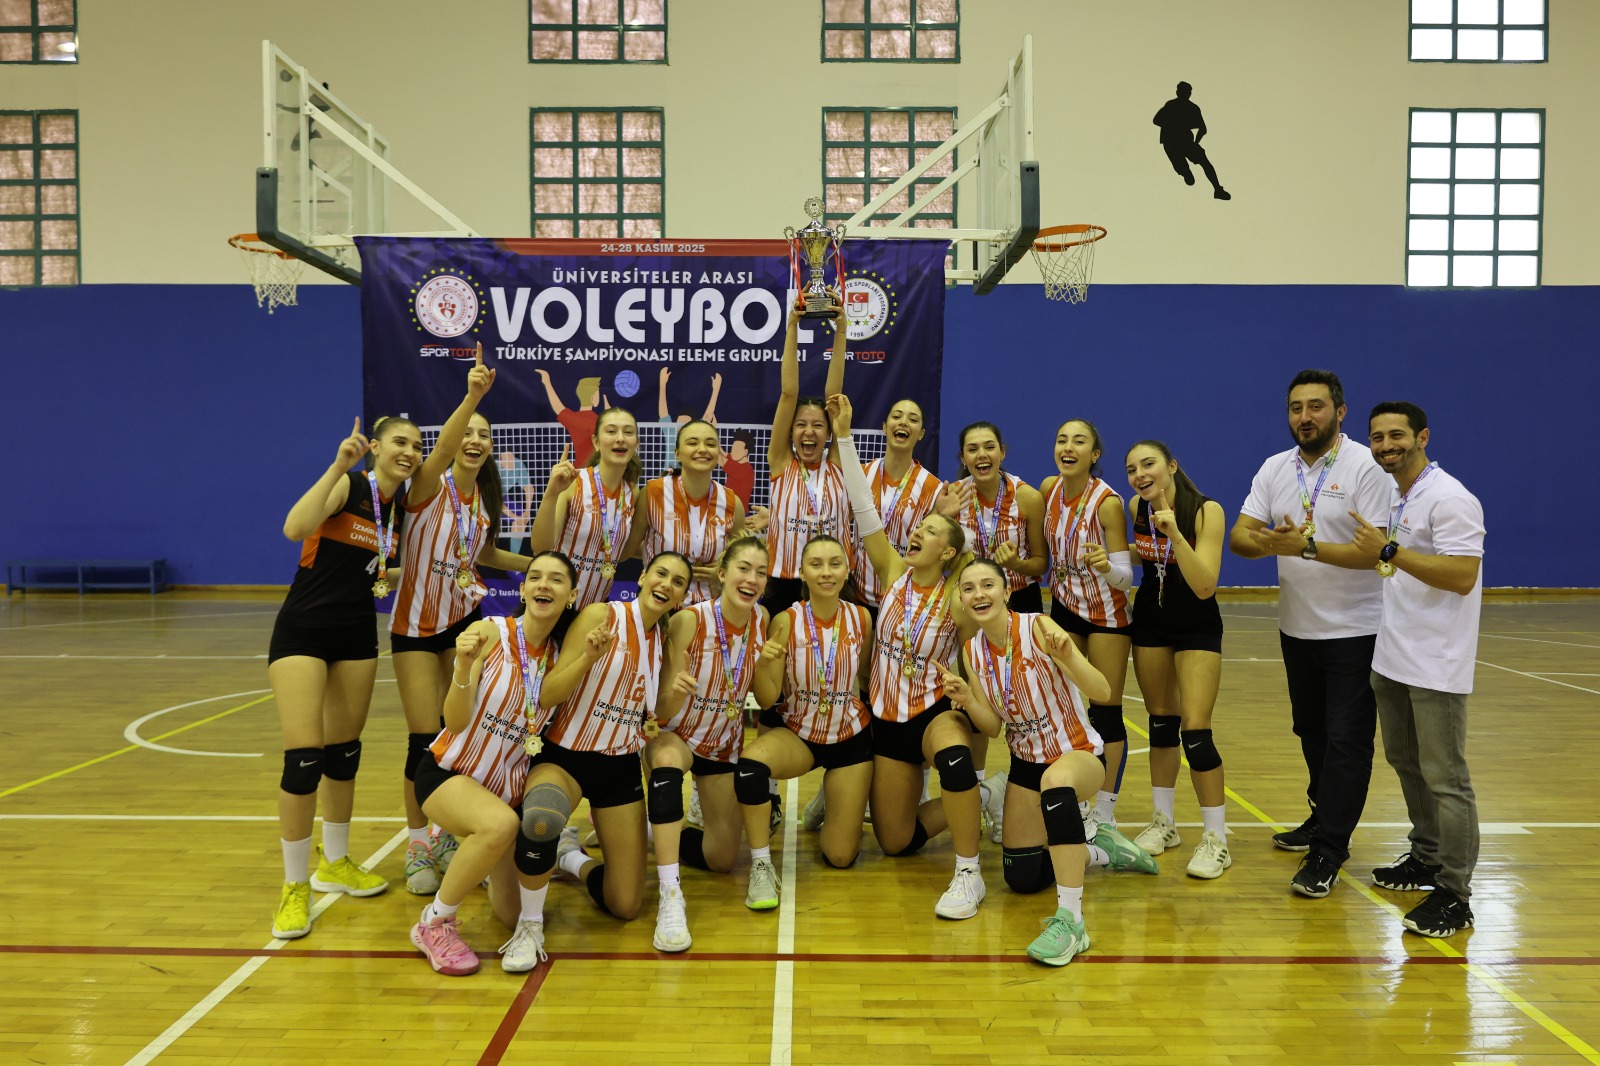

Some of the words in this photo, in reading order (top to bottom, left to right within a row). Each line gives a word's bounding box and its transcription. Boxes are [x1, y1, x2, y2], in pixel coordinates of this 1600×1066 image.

[601, 243, 632, 253] 24-28
[635, 243, 674, 253] KASIM
[677, 244, 705, 253] 2025
[552, 267, 692, 284] ÜNİVERSİTELER
[698, 271, 753, 284] ARASI
[496, 344, 562, 361] TÜRKİYE
[564, 344, 674, 364] ŞAMPİYONASI
[678, 348, 726, 362] ELEME
[498, 589, 521, 597] tusfe
[596, 699, 622, 714] İZMİR
[484, 710, 509, 727] İZMİR
